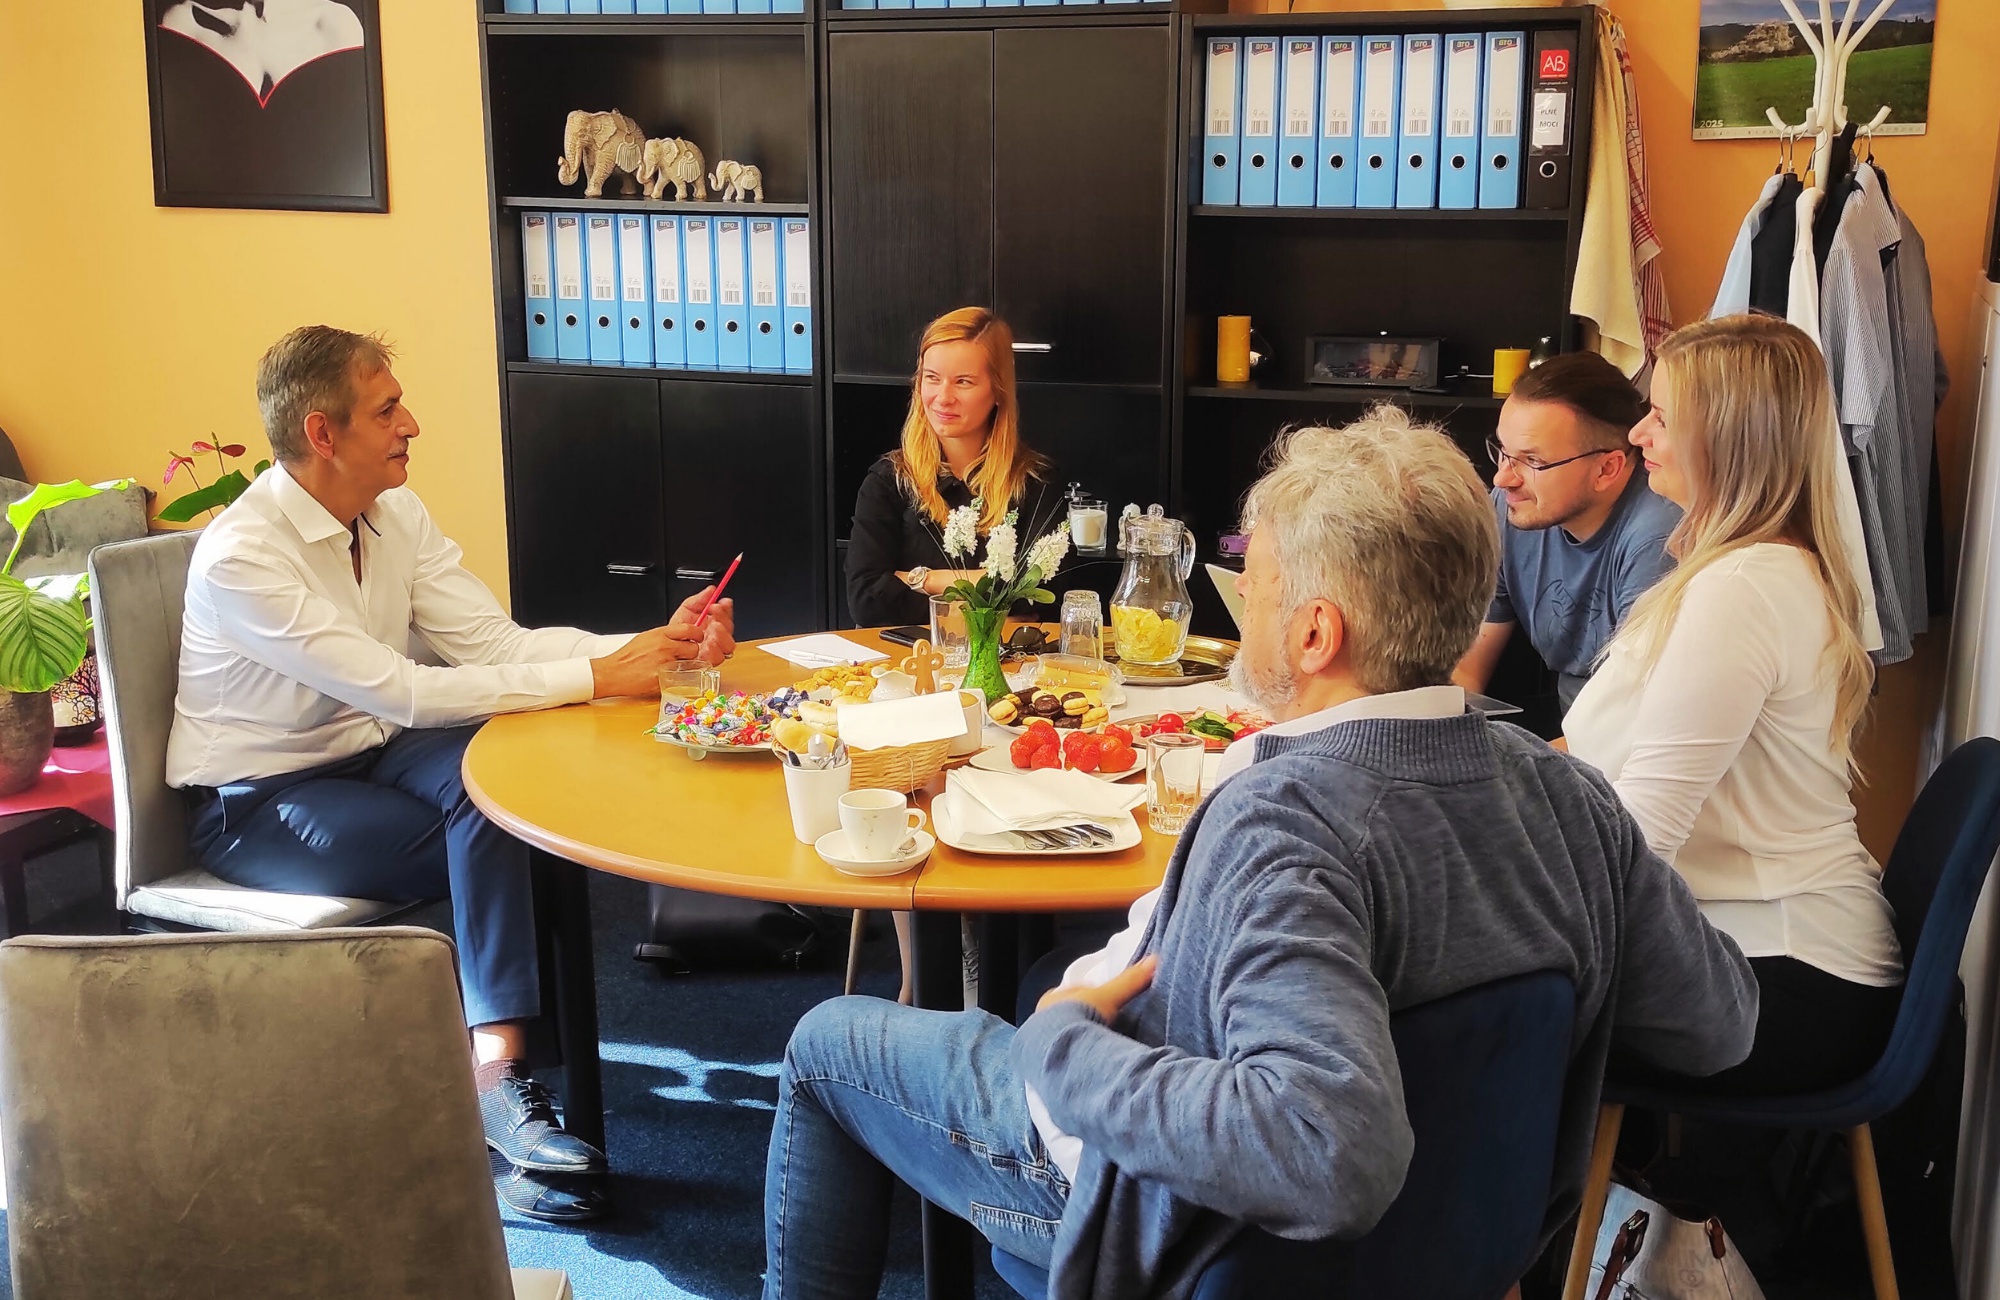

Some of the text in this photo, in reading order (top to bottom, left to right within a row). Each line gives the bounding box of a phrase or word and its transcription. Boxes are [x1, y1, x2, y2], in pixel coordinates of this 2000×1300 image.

[1498, 38, 1512, 46] aro
[1543, 56, 1566, 72] AB
[1700, 120, 1724, 128] 2025
